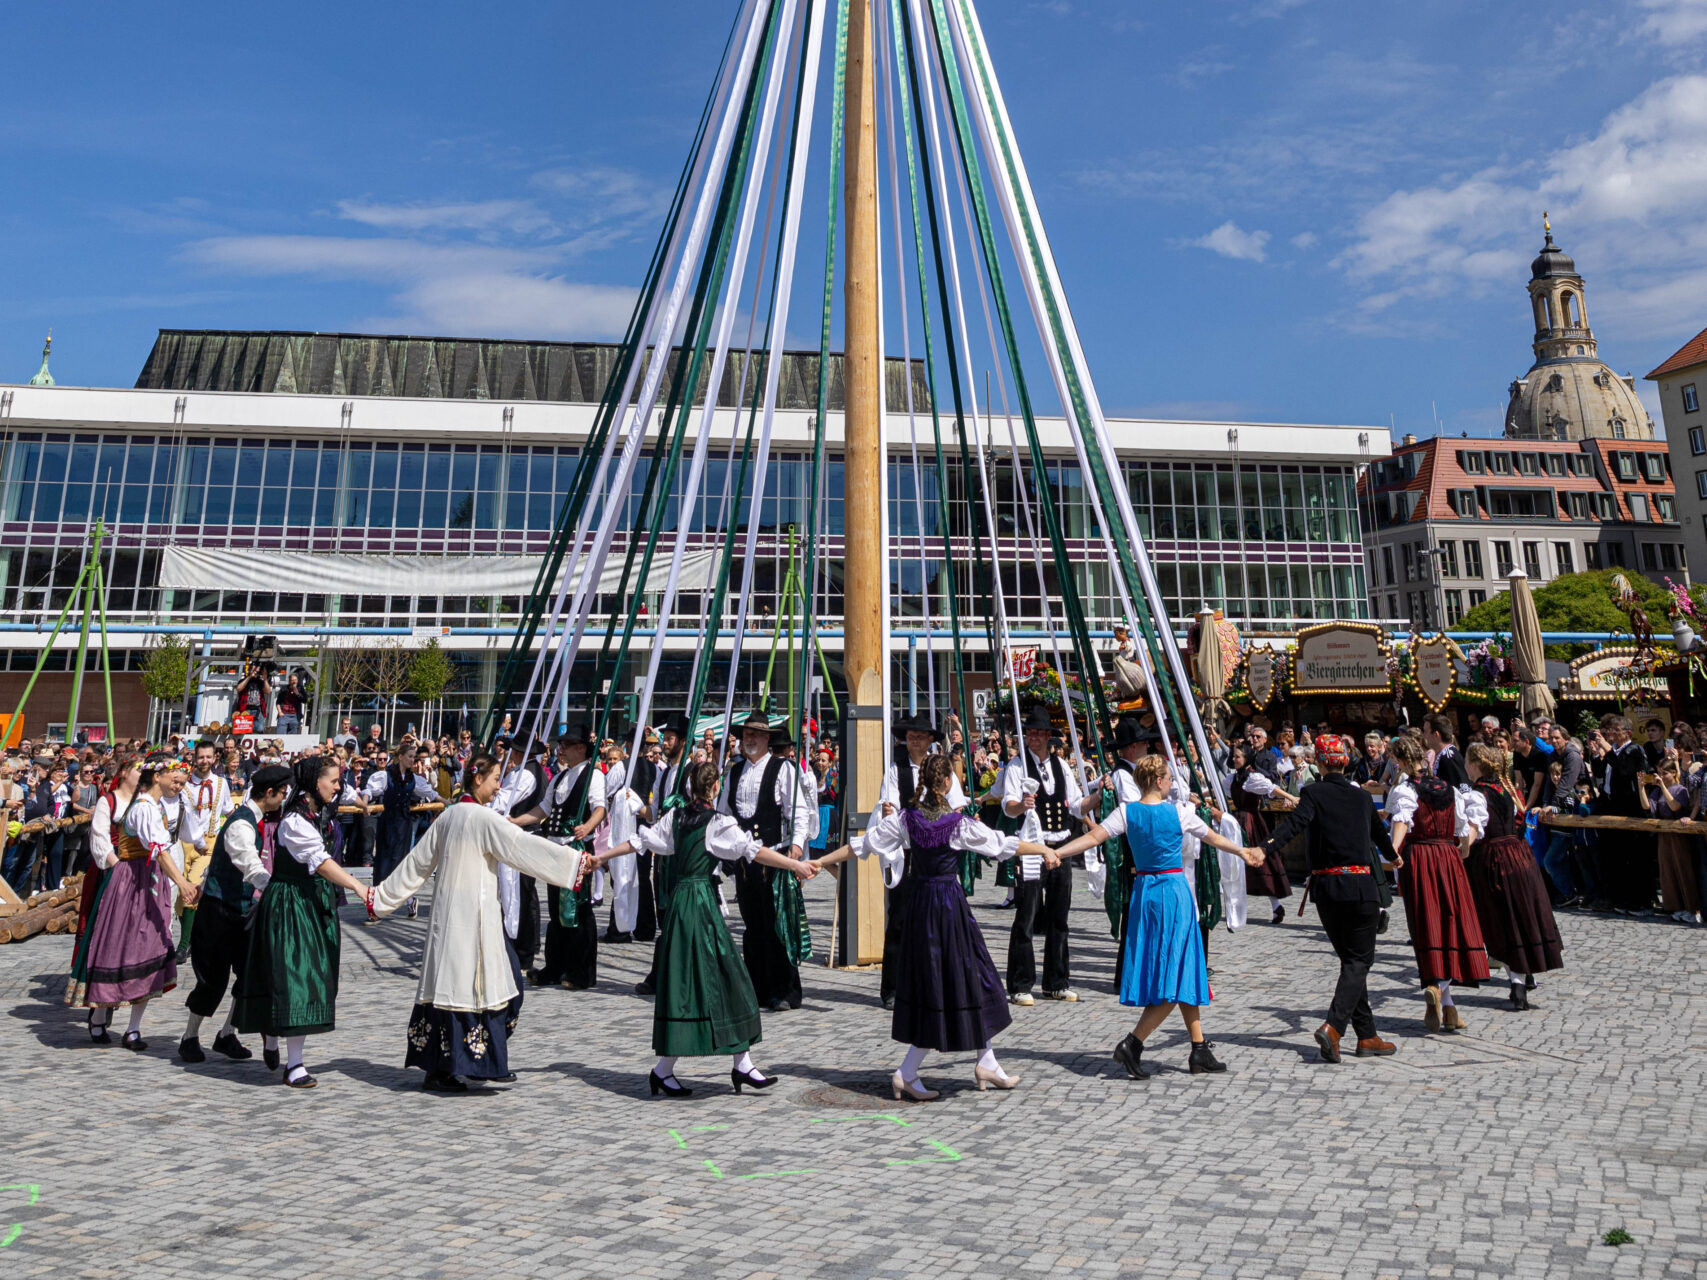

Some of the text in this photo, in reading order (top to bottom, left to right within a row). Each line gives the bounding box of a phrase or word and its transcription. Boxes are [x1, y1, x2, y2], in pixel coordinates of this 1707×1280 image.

[1014, 649, 1035, 661] SOFT
[1012, 658, 1034, 677] EIS
[1306, 661, 1375, 683] Biergärtchen
